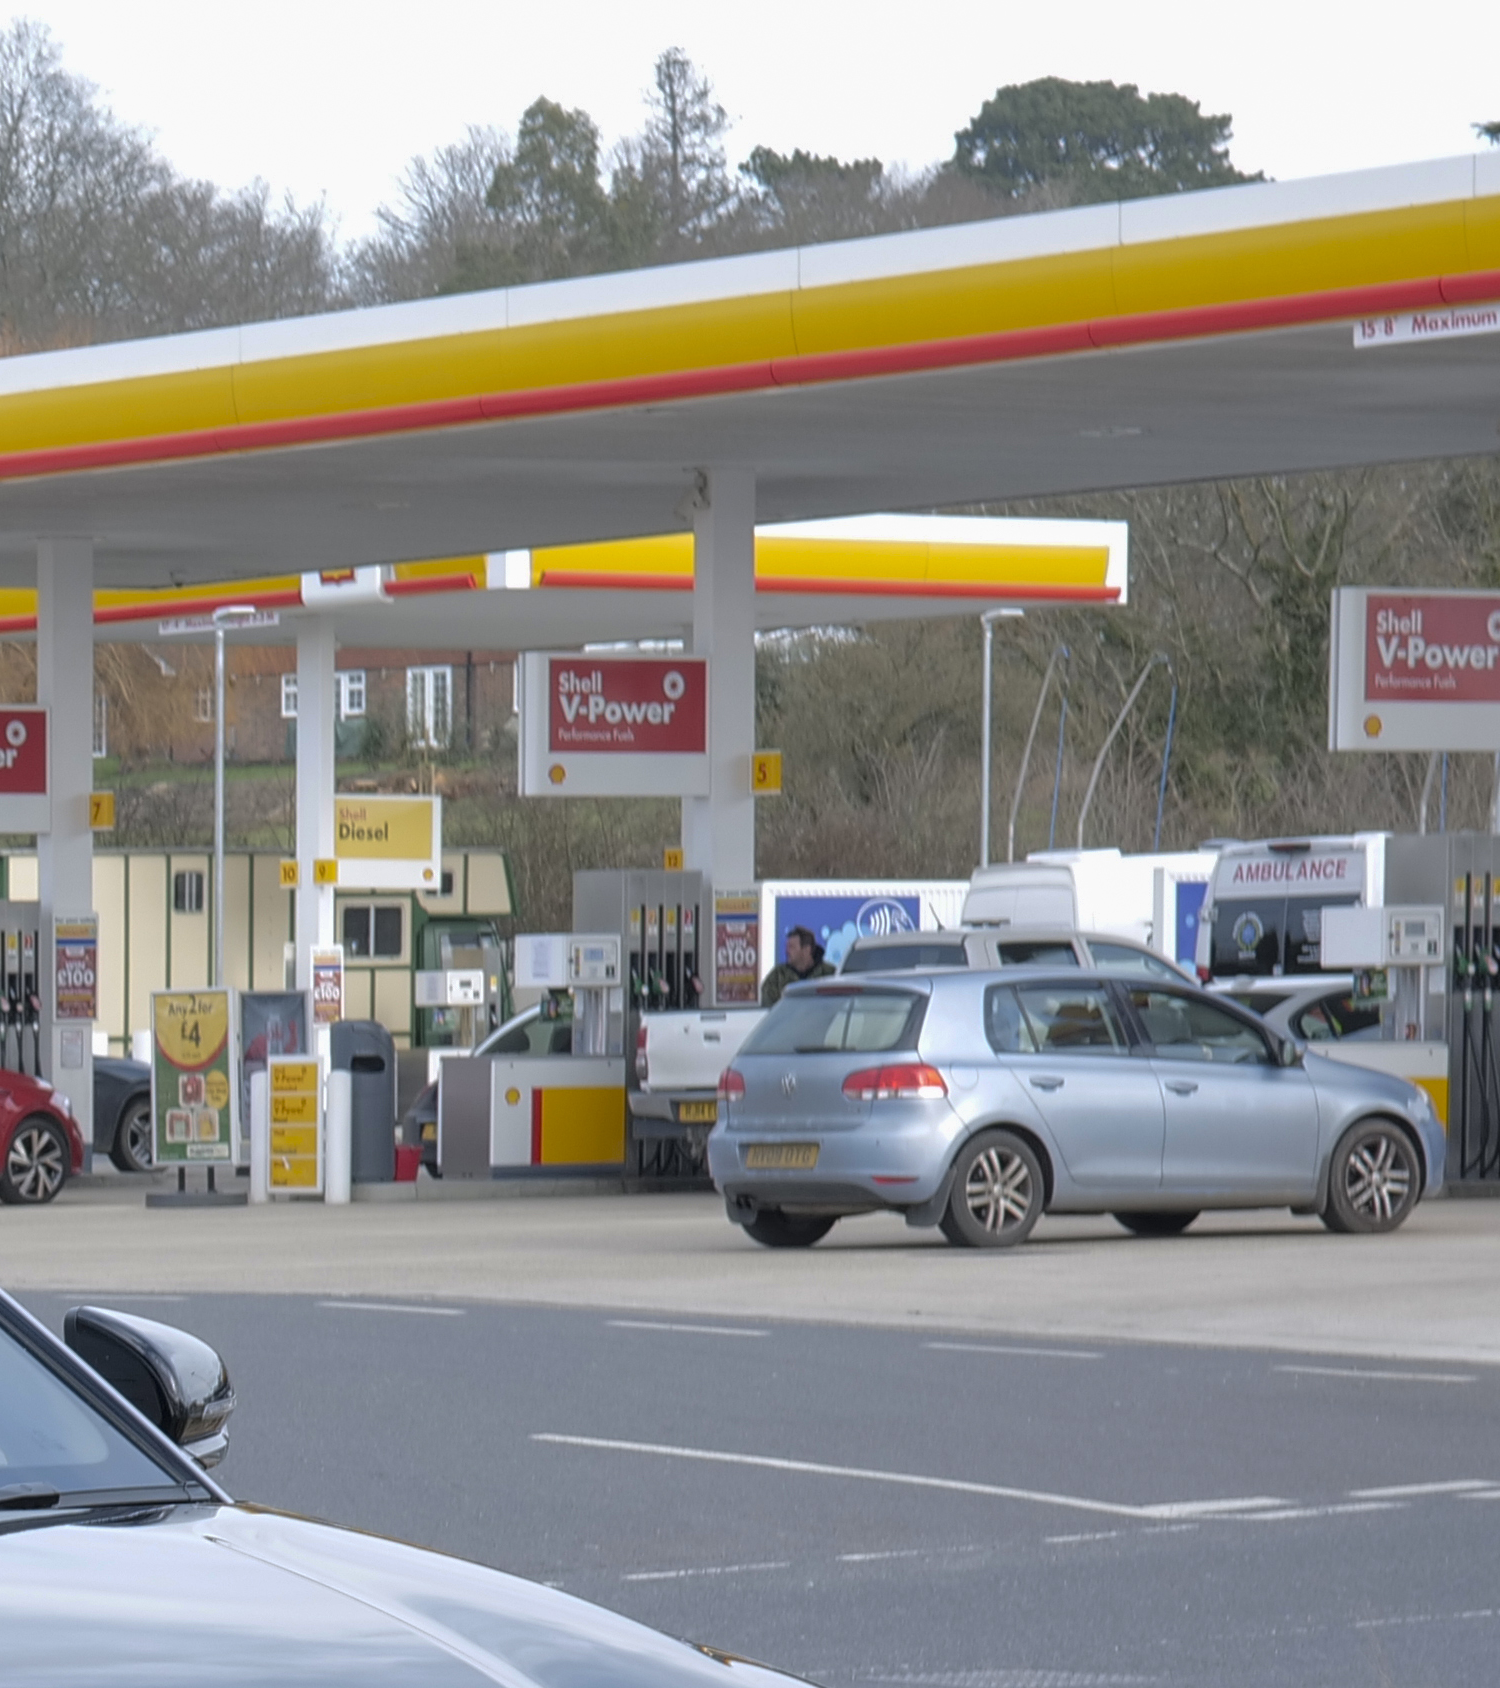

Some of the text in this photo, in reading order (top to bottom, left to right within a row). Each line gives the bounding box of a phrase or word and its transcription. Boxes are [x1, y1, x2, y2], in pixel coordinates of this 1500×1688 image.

[1411, 309, 1498, 334] Maximum
[1376, 608, 1422, 635] Shell
[1376, 635, 1500, 670] V-Power
[558, 671, 603, 693] Shell
[1375, 672, 1457, 689] Performance Fuels
[559, 695, 675, 725] V-Power
[558, 726, 635, 742] Performance Fuels
[757, 763, 767, 783] 5
[93, 802, 101, 822] 7
[339, 808, 366, 820] Shell
[339, 821, 388, 842] Diesel
[283, 866, 295, 879] 10
[319, 866, 326, 878] 9
[1233, 858, 1347, 884] AMBULANCE
[718, 946, 756, 968] £100
[57, 969, 94, 987] £100
[168, 994, 213, 1018] Any 2 for
[181, 1020, 201, 1048] £4
